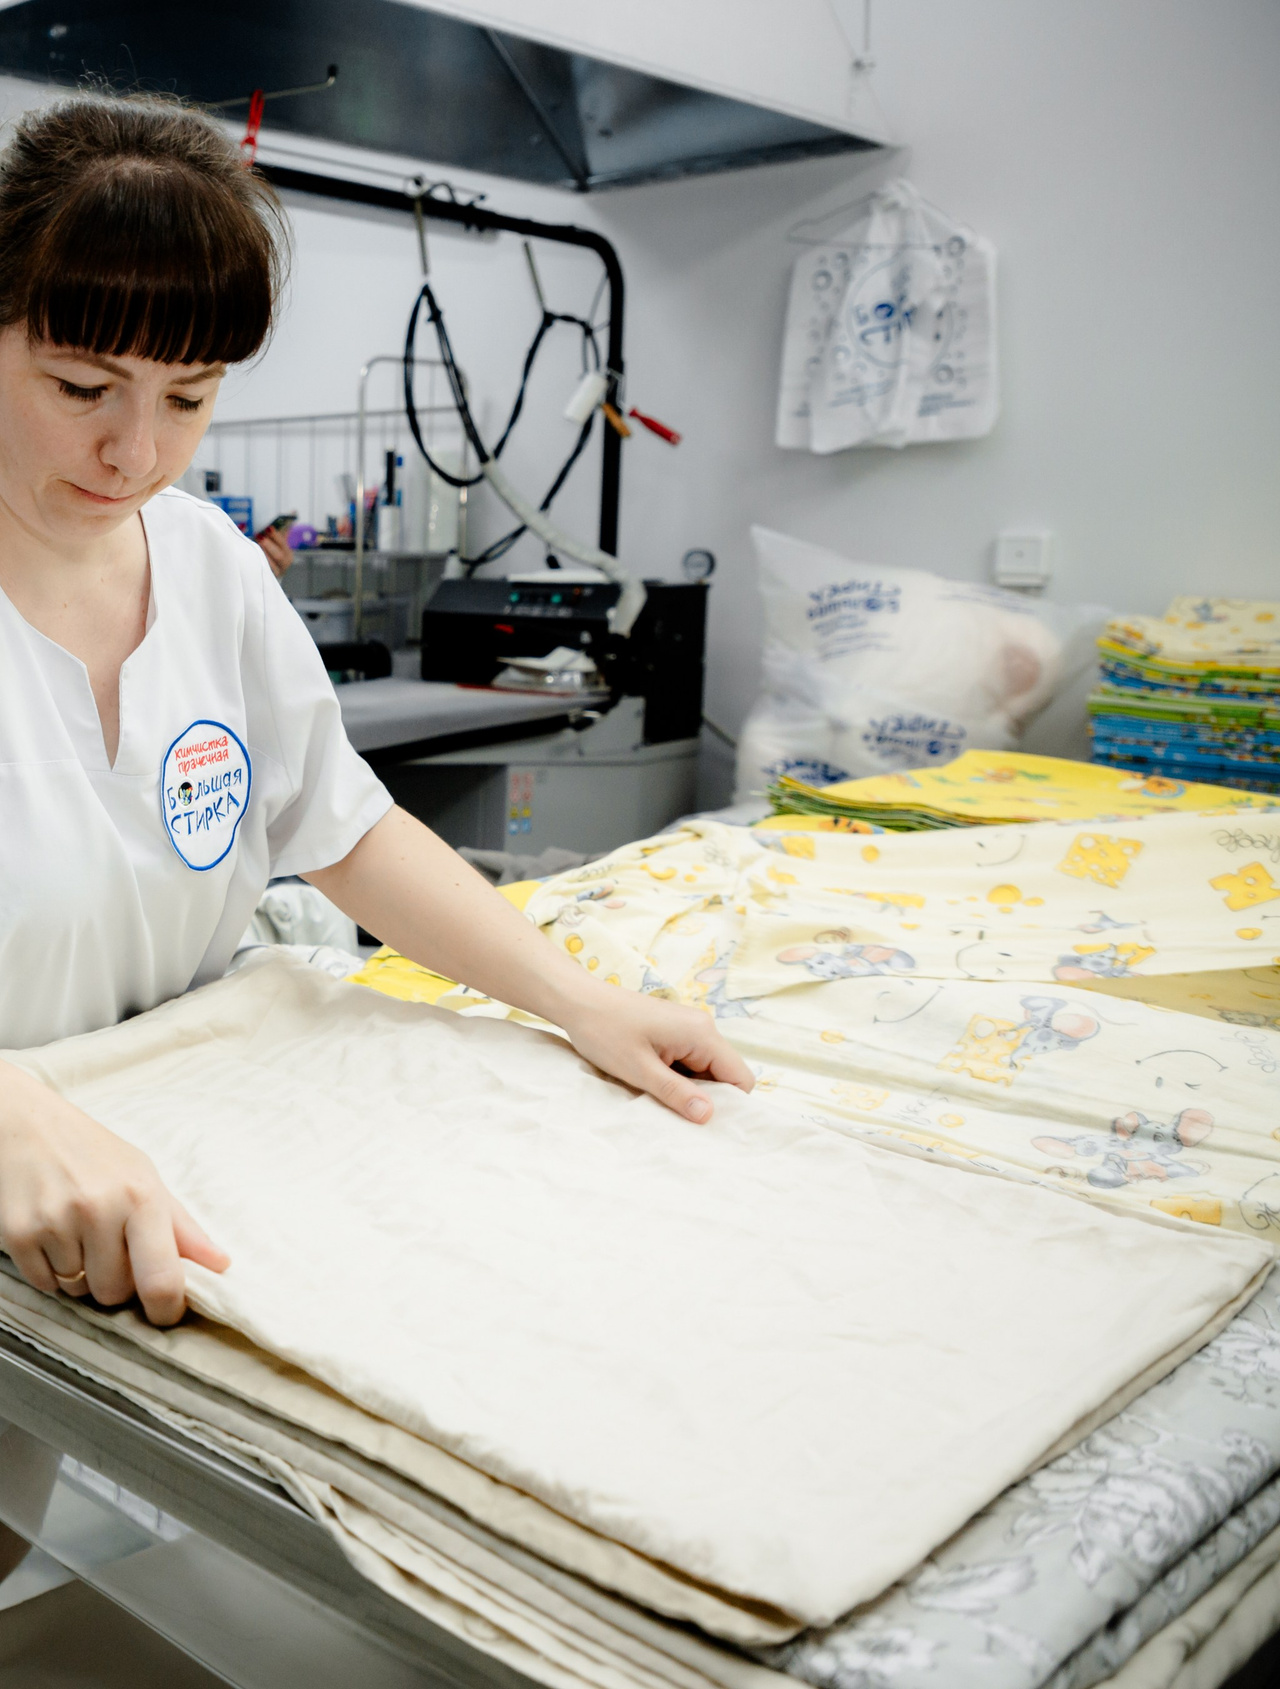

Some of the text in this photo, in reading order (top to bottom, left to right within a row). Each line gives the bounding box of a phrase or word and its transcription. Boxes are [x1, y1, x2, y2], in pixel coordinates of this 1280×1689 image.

[174, 735, 229, 761] химчистка
[177, 748, 229, 776] прачечная
[170, 791, 240, 835] СТИРКА
